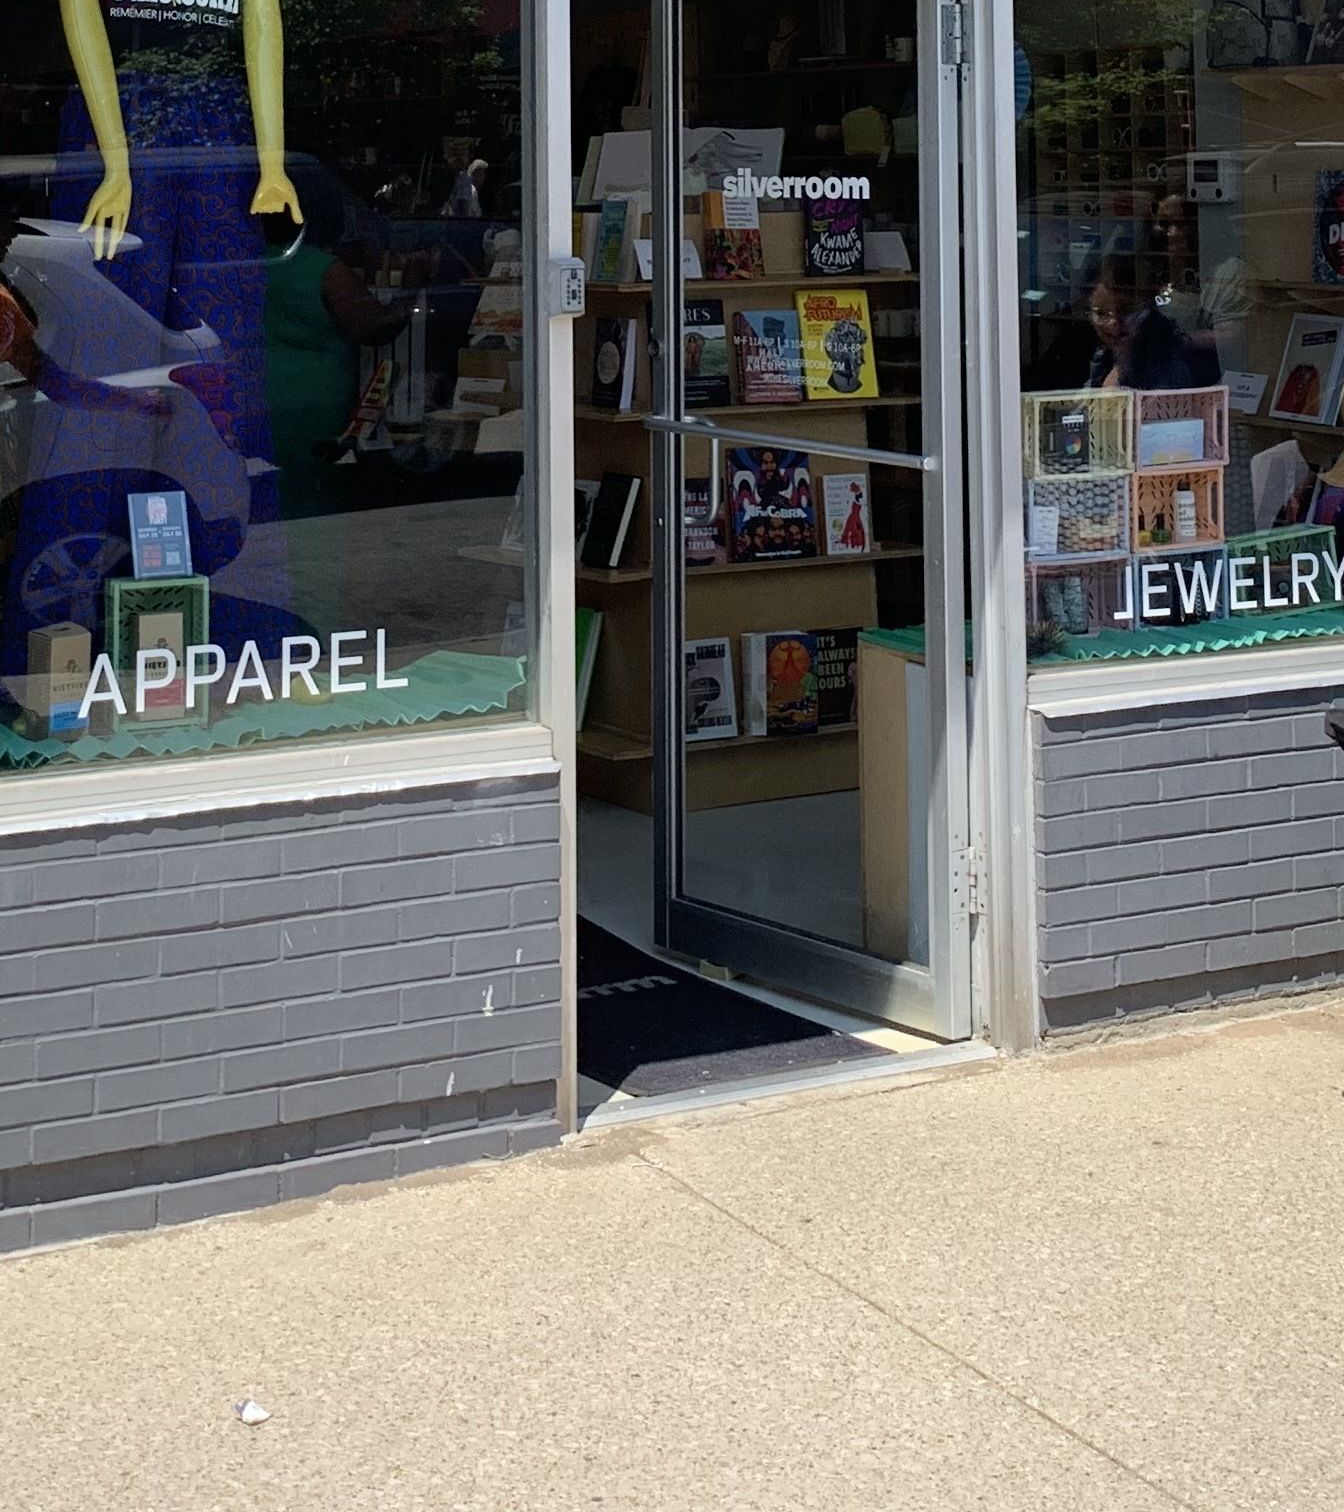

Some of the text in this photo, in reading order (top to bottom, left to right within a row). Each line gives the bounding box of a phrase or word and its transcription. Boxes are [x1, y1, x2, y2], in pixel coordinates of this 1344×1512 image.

[723, 168, 870, 200] silverroom
[820, 227, 859, 249] KWAME
[817, 647, 856, 662] ALWAYS
[78, 628, 409, 719] APPAREL
[817, 662, 845, 676] BEEN
[819, 676, 847, 690] OURS
